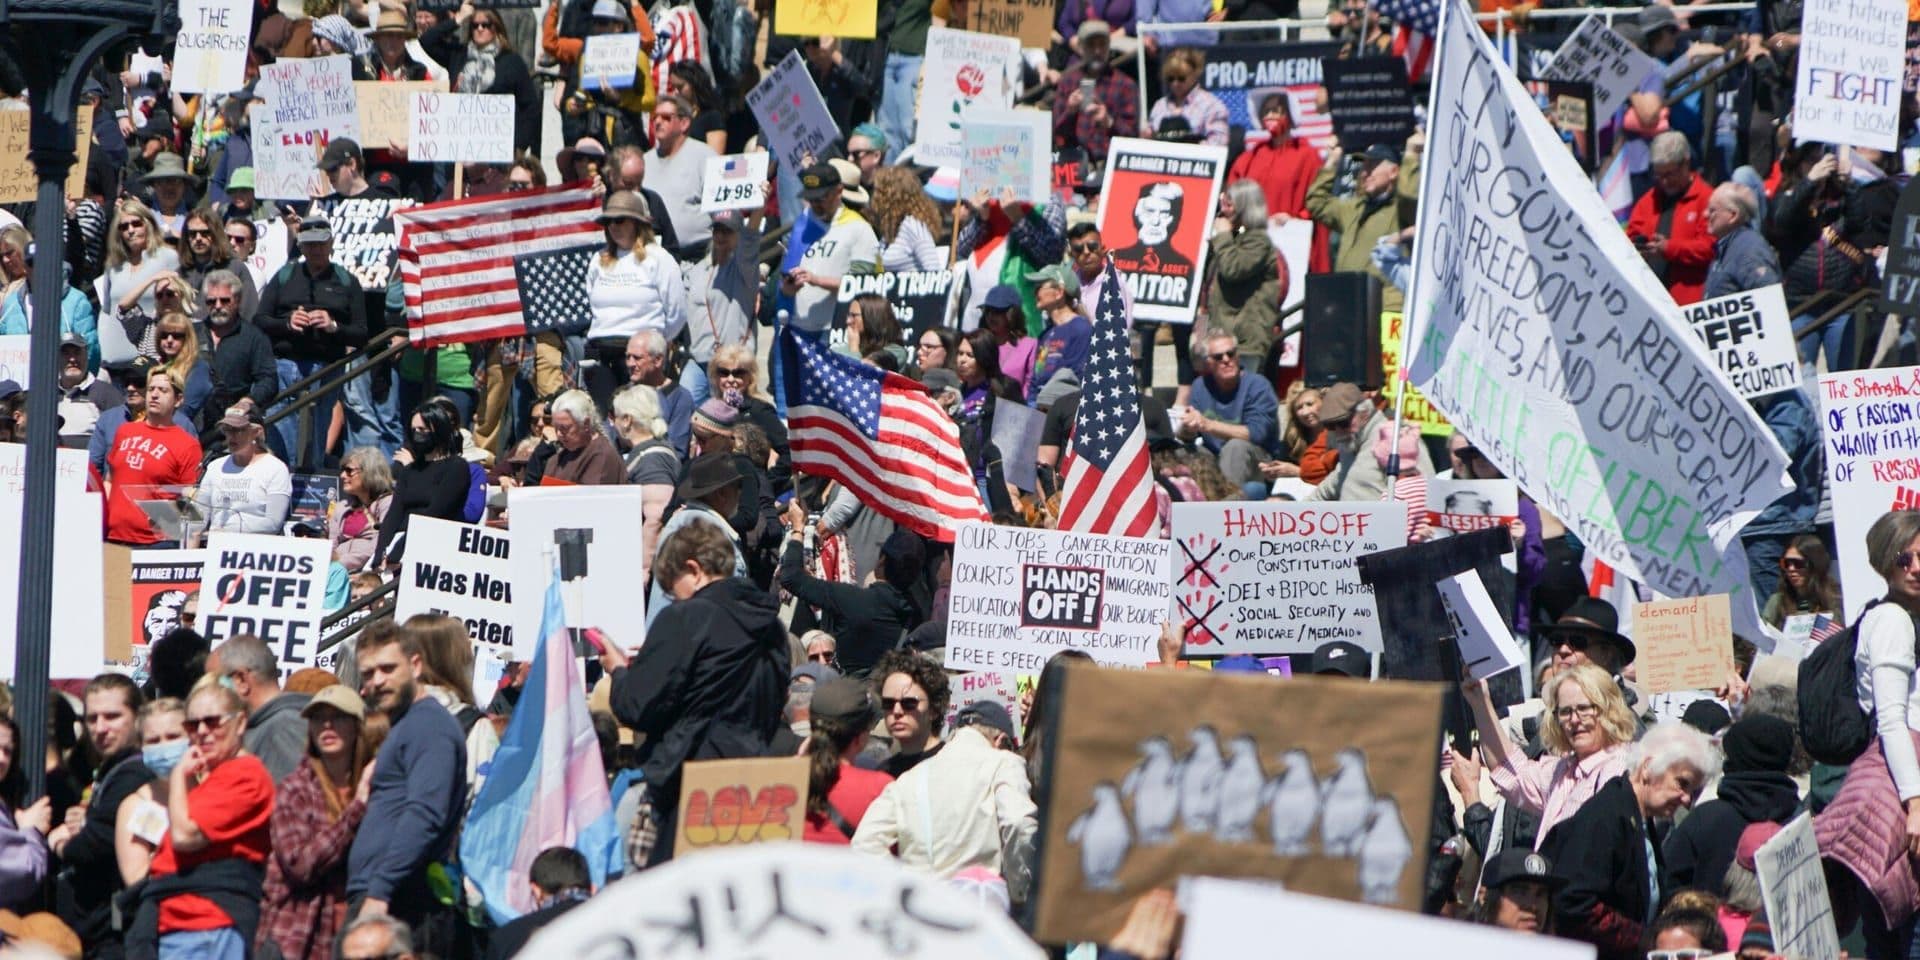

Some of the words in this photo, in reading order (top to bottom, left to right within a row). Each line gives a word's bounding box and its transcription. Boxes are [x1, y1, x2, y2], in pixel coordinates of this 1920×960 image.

[199, 7, 231, 28] THE
[178, 33, 247, 51] OLIGARCHS
[1602, 28, 1632, 57] ONLY
[1805, 16, 1900, 48] demands
[1611, 57, 1629, 77] TO
[1805, 40, 1847, 67] that
[1860, 55, 1889, 74] we
[1808, 67, 1897, 106] FIGHT
[418, 93, 440, 114] NO
[458, 93, 511, 114] KINGS
[1798, 97, 1824, 122] for
[1832, 108, 1845, 124] it
[418, 118, 440, 137] NO
[418, 141, 438, 161] NO
[449, 140, 510, 161] NAZIS
[1118, 154, 1129, 170] A
[1128, 156, 1166, 174] DANGER
[1167, 159, 1180, 175] TO
[1181, 162, 1193, 176] US
[1192, 162, 1212, 178] ALL
[1161, 262, 1189, 276] ASSET
[838, 271, 896, 302] DUMP
[897, 270, 953, 297] TRUMP
[1694, 310, 1765, 351] FF!
[1747, 351, 1758, 367] &
[1731, 361, 1796, 395] ECURITY
[1820, 378, 1849, 400] The
[1853, 375, 1908, 400] Strength
[1828, 406, 1849, 432] OF
[119, 435, 168, 460] UTAH
[1547, 431, 1607, 506] OF
[1836, 461, 1856, 483] OF
[1223, 508, 1316, 538] HANDS
[1319, 511, 1374, 538] OFF
[1440, 513, 1501, 534] RESIST
[459, 527, 510, 560] Elon
[961, 525, 1000, 551] OUR
[1003, 530, 1047, 552] JOBS
[1061, 534, 1113, 555] CANCER
[1114, 539, 1170, 558] RESEARCH
[1228, 549, 1256, 564] OUR
[1259, 539, 1356, 558] DEMOCRACY
[1362, 542, 1379, 553] AND
[140, 568, 172, 580] DANGER
[173, 568, 185, 580] TO
[185, 568, 196, 580] US
[220, 551, 315, 575] HANDS
[1017, 550, 1049, 564] THE
[1055, 551, 1158, 576] CONSTITUTION
[1256, 558, 1353, 577] CONSTITUTION
[216, 572, 312, 609] OFF!
[415, 562, 468, 595] Was
[956, 561, 1015, 587] COURTS
[1104, 575, 1170, 599] IMMIGRANTS
[1026, 567, 1101, 597] HANDS
[1227, 581, 1261, 603] DEI
[1279, 579, 1330, 600] BIPOC
[952, 595, 1021, 618] EDUCATION
[1101, 601, 1121, 621] OUR
[1127, 605, 1167, 625] BODIES
[1027, 590, 1097, 622] OFF!
[1236, 606, 1282, 624] SOCIAL
[1288, 604, 1347, 622] SECURITY
[1353, 608, 1371, 618] AND
[1640, 596, 1698, 618] demand
[950, 619, 978, 641] FREE
[1031, 629, 1078, 648] SOCIAL
[1082, 632, 1152, 652] SECURITY
[1235, 628, 1295, 641] MEDICARE
[952, 646, 996, 661] FREE
[962, 671, 1003, 692] HOME
[684, 784, 799, 848] LOVE
